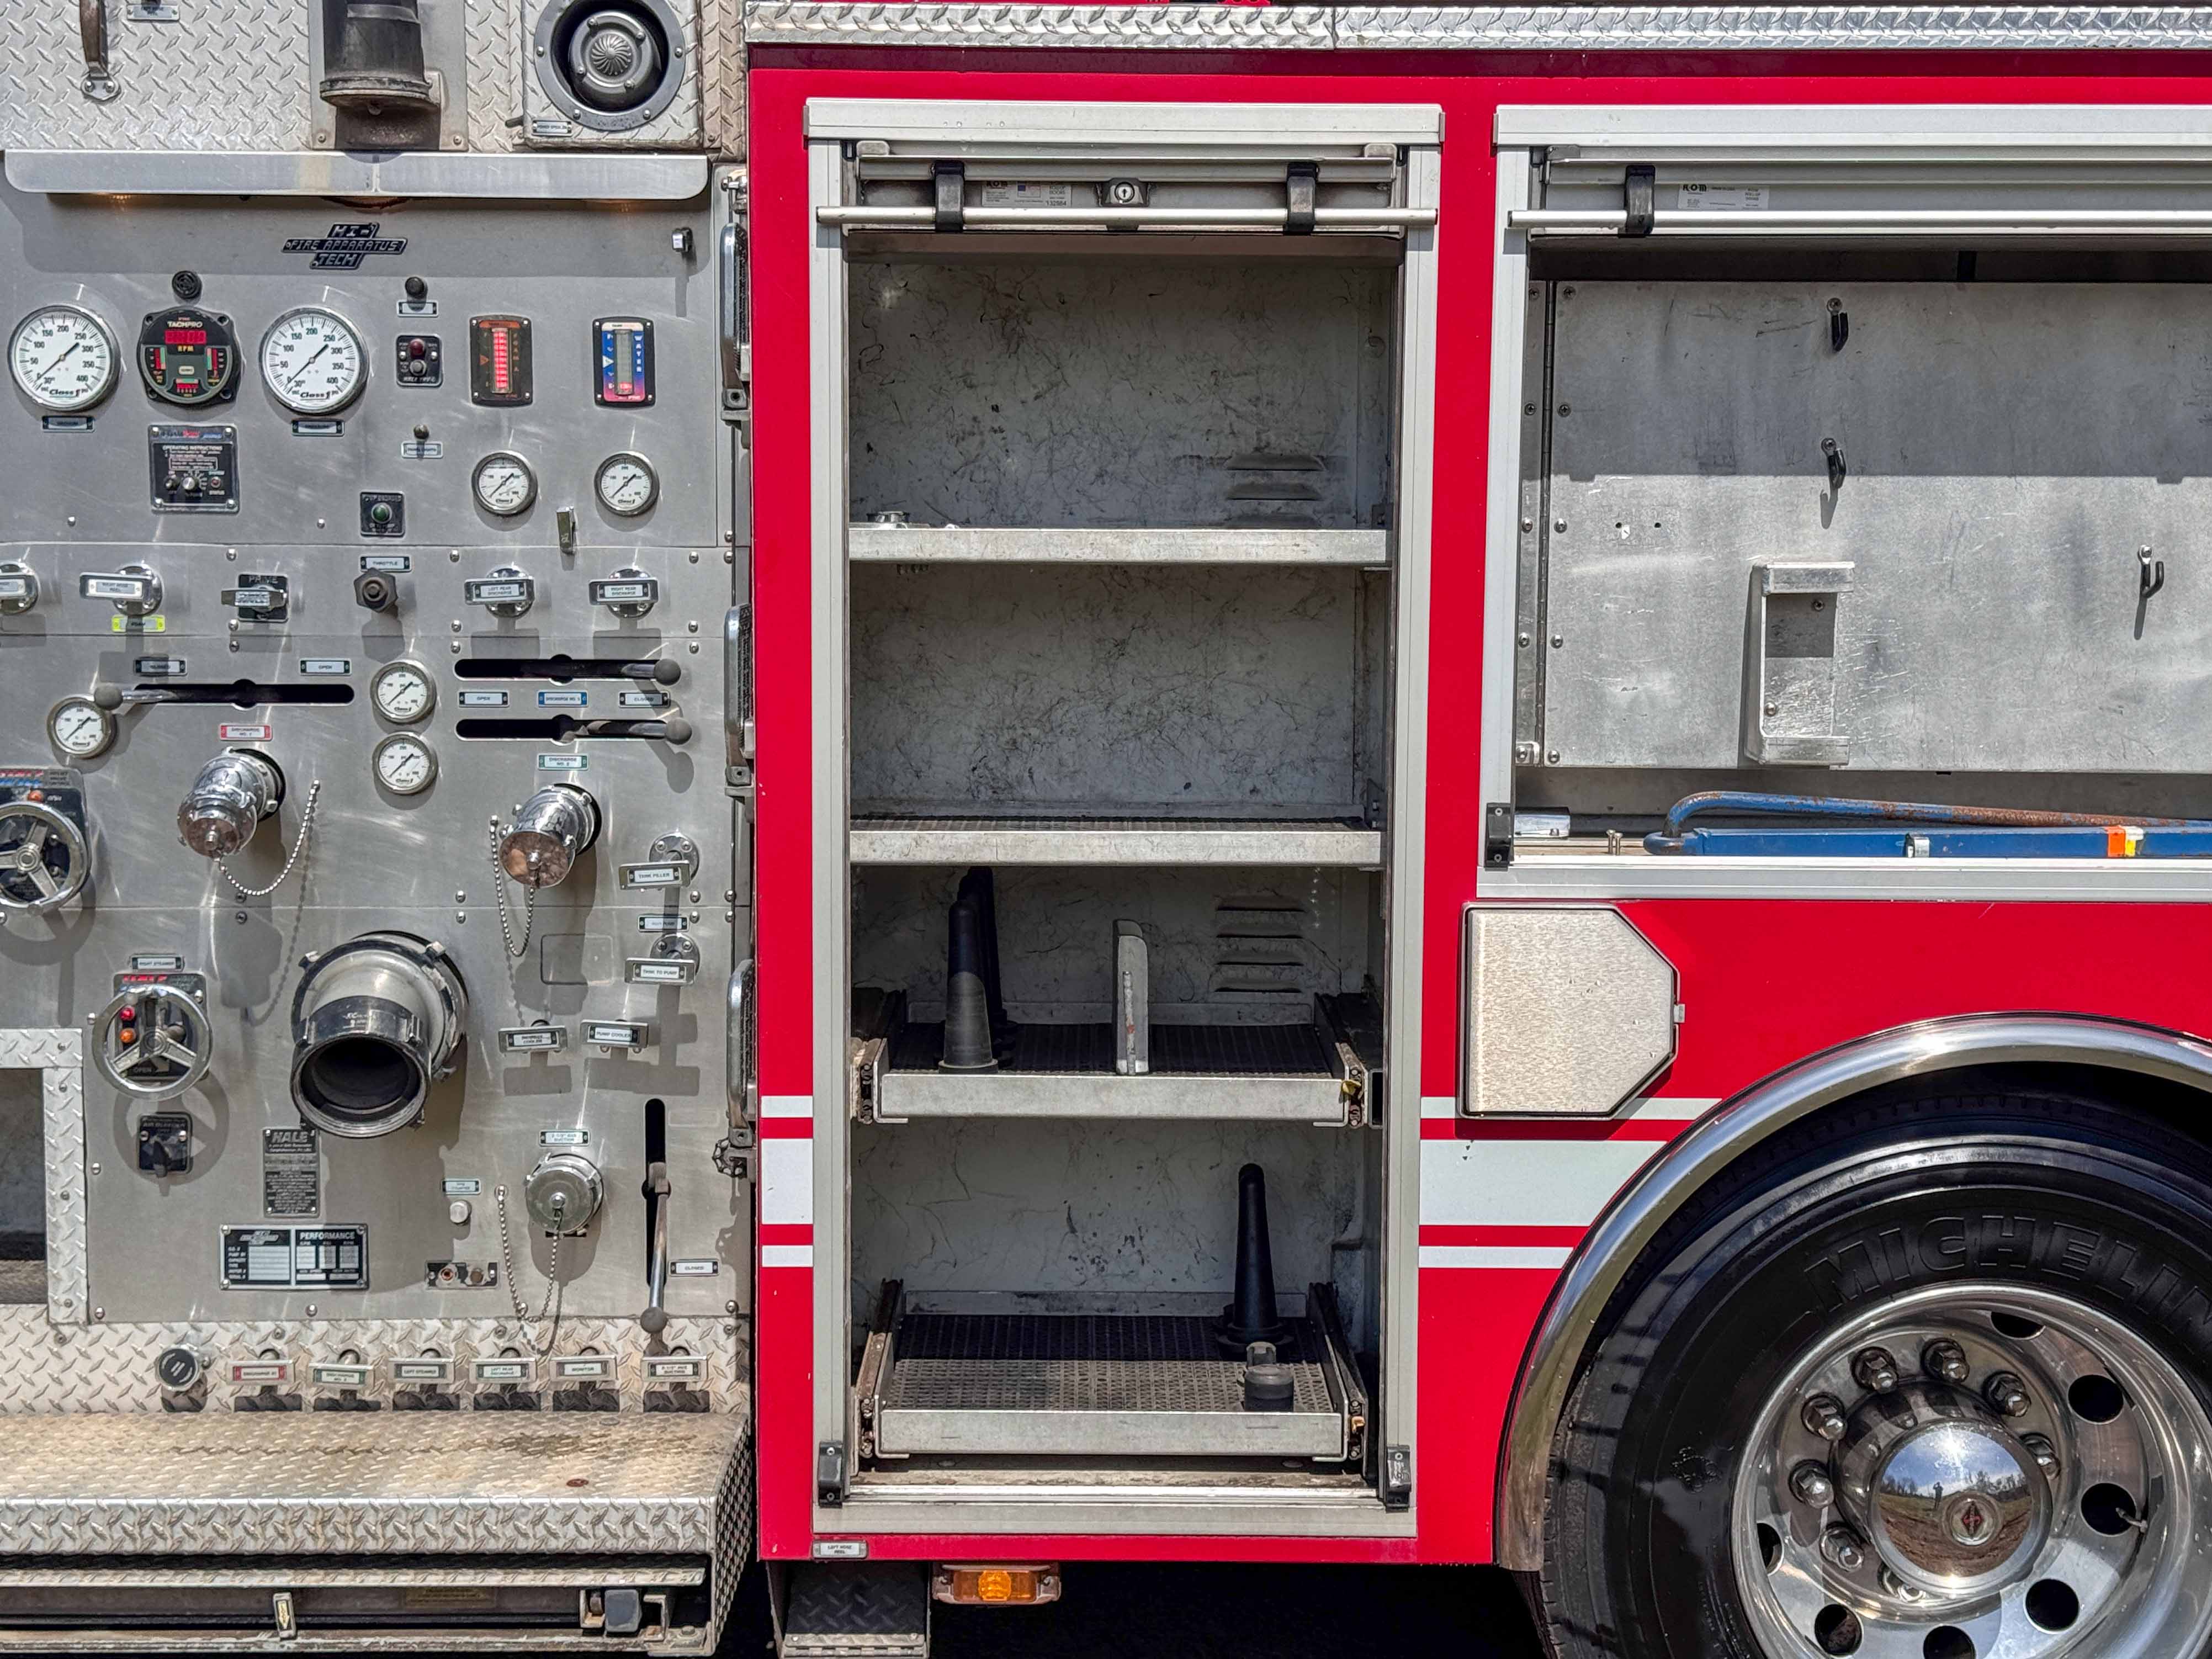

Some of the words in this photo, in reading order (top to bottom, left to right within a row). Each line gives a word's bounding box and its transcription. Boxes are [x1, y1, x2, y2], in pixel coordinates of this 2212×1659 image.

[290, 240, 321, 250] FIRE
[323, 240, 399, 252] APPARATUS
[319, 253, 358, 266] TECH
[248, 575, 279, 584] PRIME
[272, 1131, 309, 1143] HALE
[300, 1232, 355, 1240] PERFORMANCE
